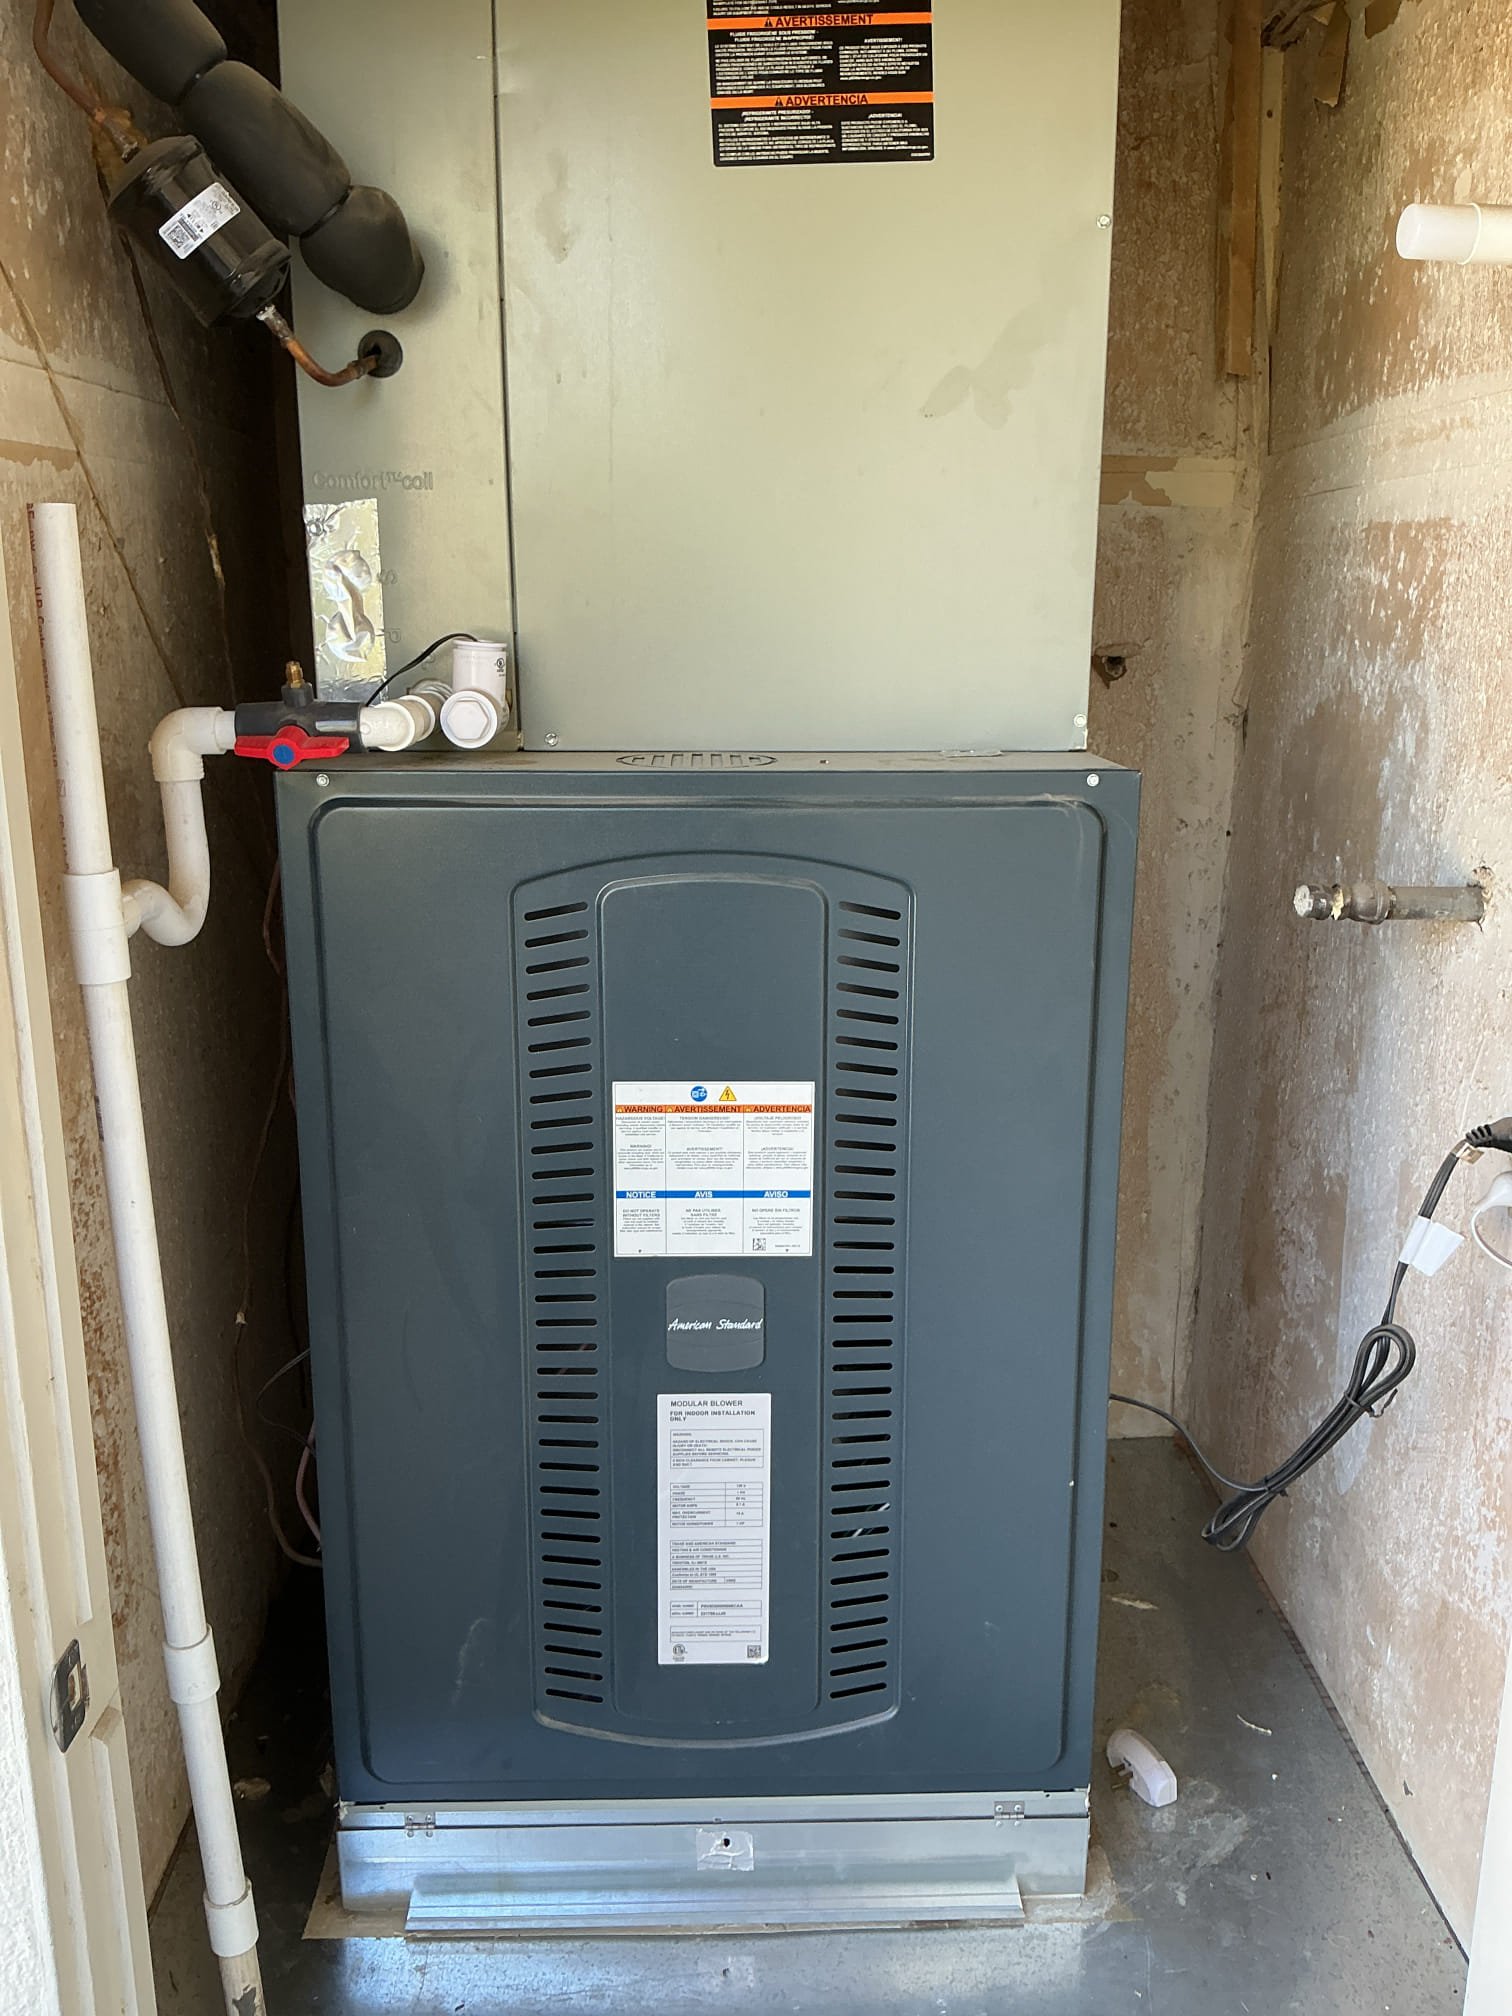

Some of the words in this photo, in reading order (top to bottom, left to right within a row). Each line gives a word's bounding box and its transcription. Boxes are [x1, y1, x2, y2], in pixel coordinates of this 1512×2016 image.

[776, 15, 873, 27] AVERTISSEMENT
[786, 94, 868, 107] ADVERTENCIA
[624, 1105, 662, 1113] WARNING
[674, 1105, 740, 1113] AVERTISSEMENT
[753, 1105, 811, 1113] ADVERTENCIA
[668, 1317, 712, 1331] American
[716, 1318, 763, 1329] Standard
